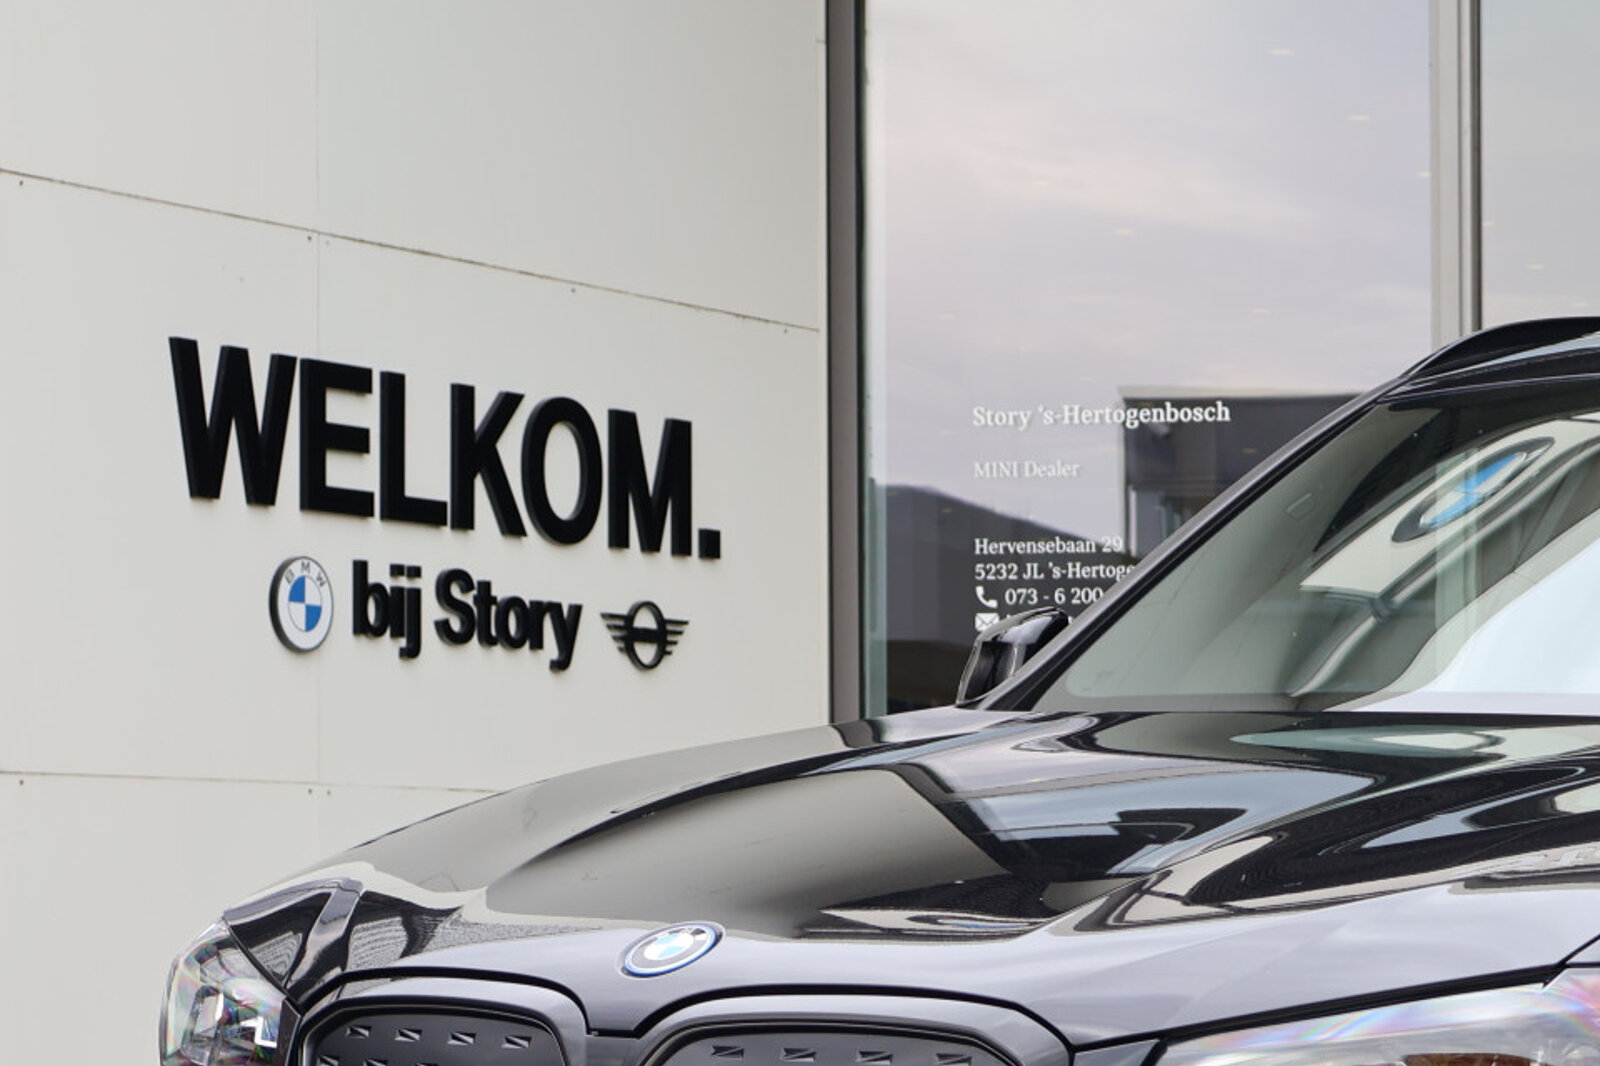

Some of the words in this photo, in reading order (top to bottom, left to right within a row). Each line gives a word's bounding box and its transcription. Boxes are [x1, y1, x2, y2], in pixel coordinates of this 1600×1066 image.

[972, 406, 1032, 431] Story
[1038, 401, 1231, 429] 's-Hertogenbosch
[168, 336, 721, 560] WELKOM.
[974, 462, 1018, 478] MINI
[1024, 459, 1080, 478] Dealer
[974, 536, 1096, 555] Hervensebaan
[1101, 536, 1123, 552] 29
[974, 563, 1018, 580] 5232
[1022, 562, 1044, 580] JL
[1048, 562, 1138, 583] 's-Hertoge
[1004, 587, 1038, 605] 073
[1054, 588, 1065, 604] 6
[1071, 587, 1104, 604] 200
[352, 559, 422, 659] bij
[434, 568, 583, 672] Story
